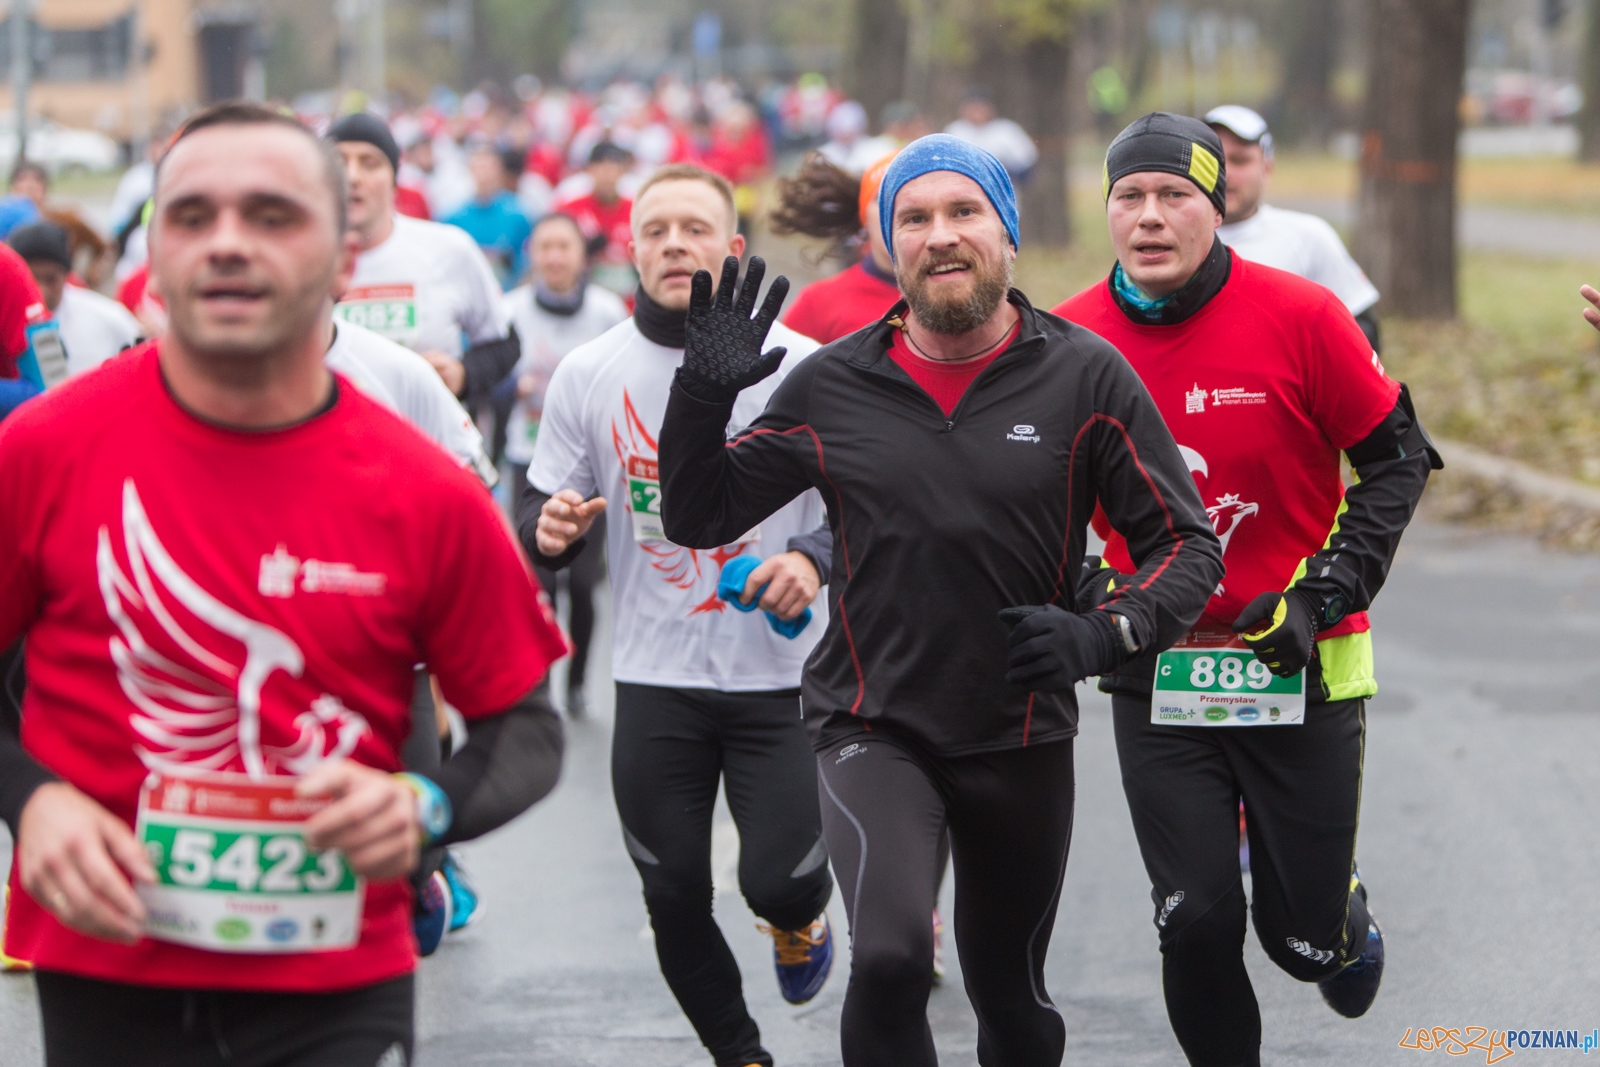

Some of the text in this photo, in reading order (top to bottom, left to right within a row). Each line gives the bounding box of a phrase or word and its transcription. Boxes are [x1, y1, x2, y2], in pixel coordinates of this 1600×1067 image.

[1160, 656, 1273, 690] C 889
[1200, 695, 1257, 704] Przemysław
[1159, 713, 1187, 721] LUXMED
